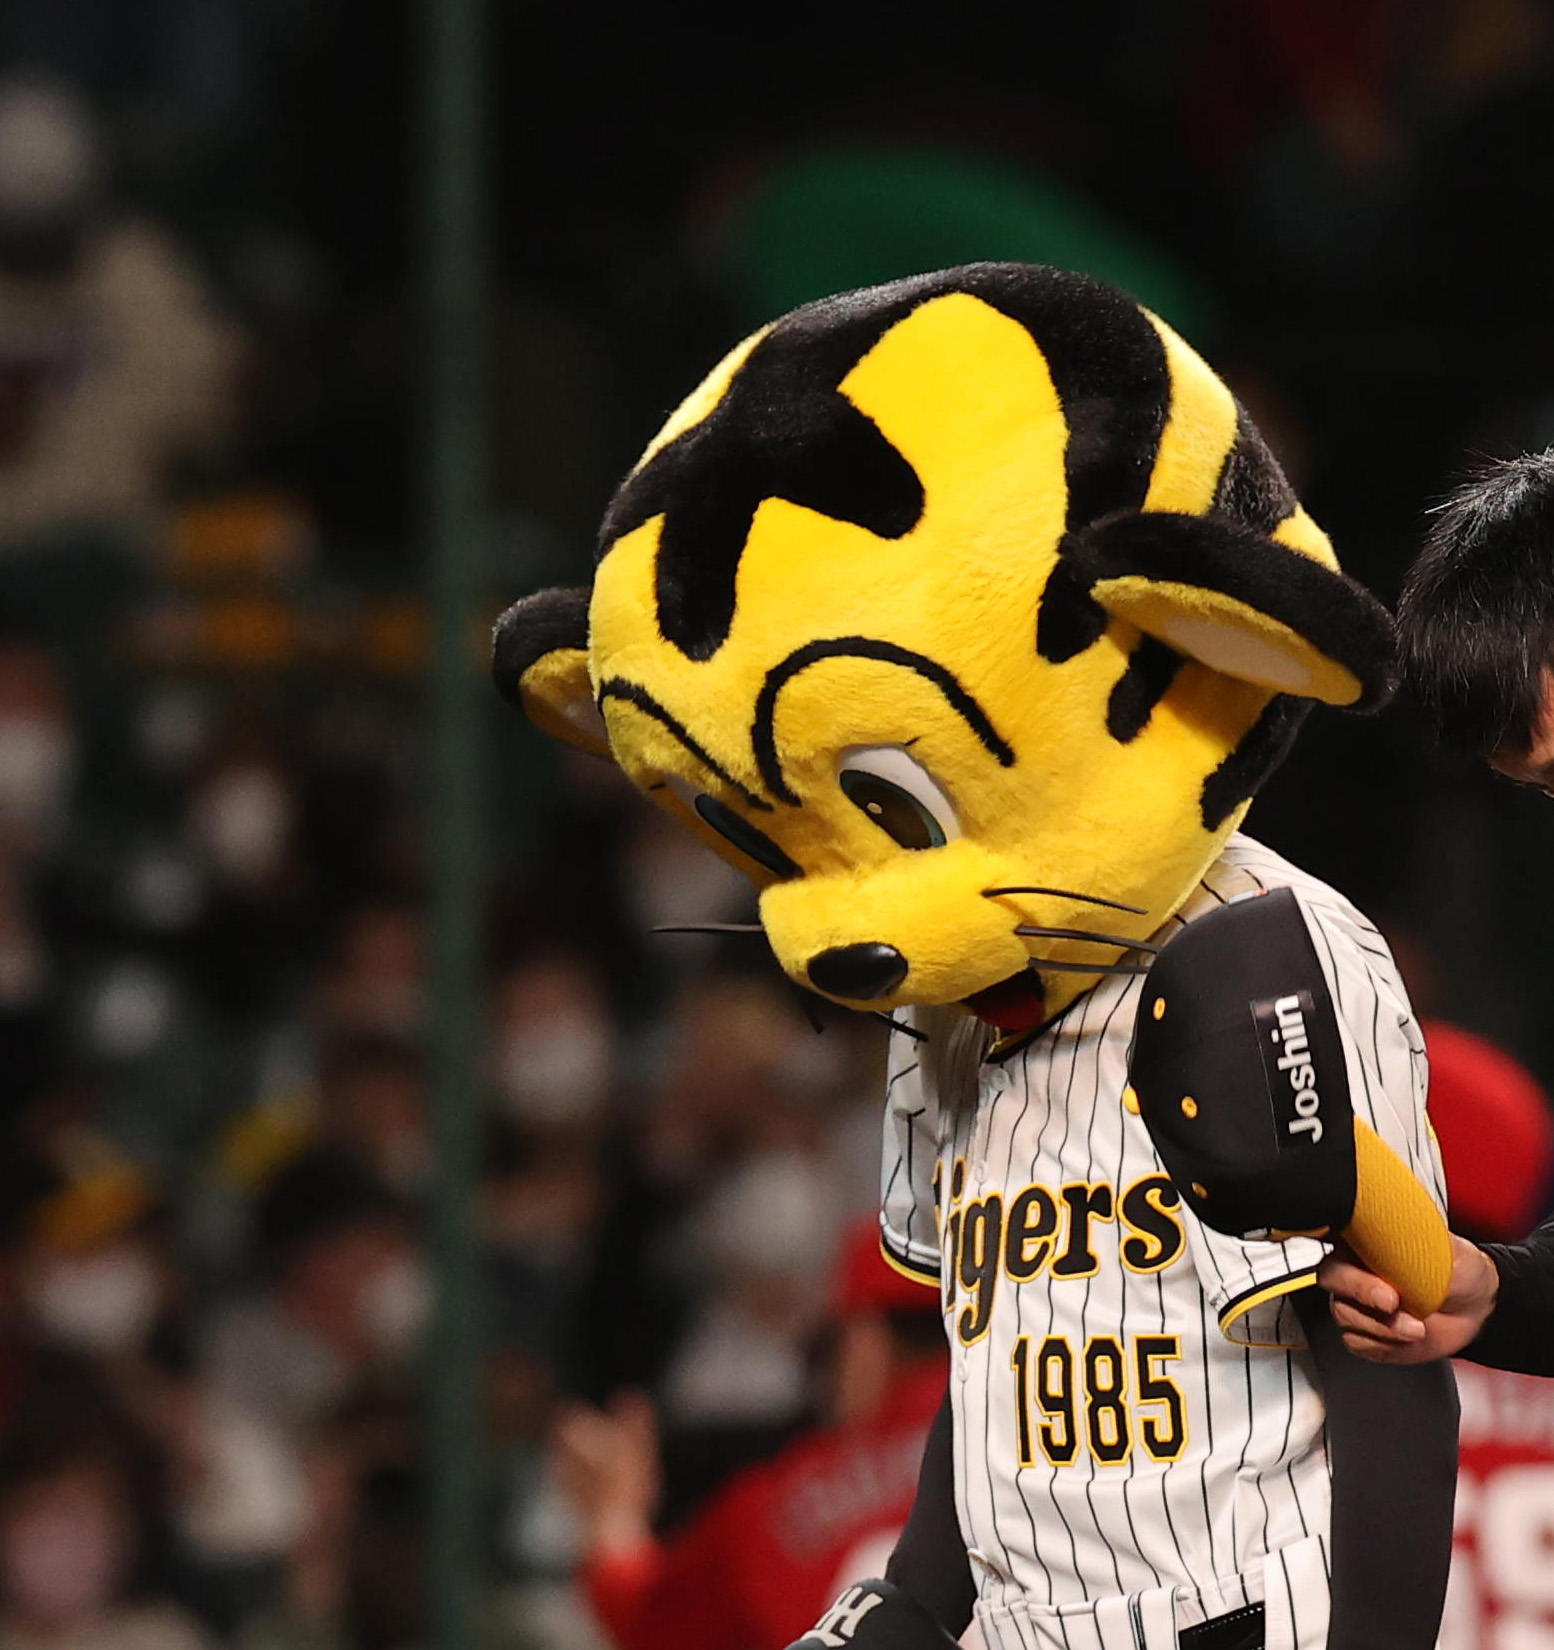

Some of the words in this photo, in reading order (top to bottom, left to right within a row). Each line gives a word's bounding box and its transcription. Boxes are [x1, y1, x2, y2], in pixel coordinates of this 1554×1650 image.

[1271, 995, 1323, 1145] Joshin
[934, 1157, 1186, 1346] igers
[1011, 1333, 1188, 1467] 1985
